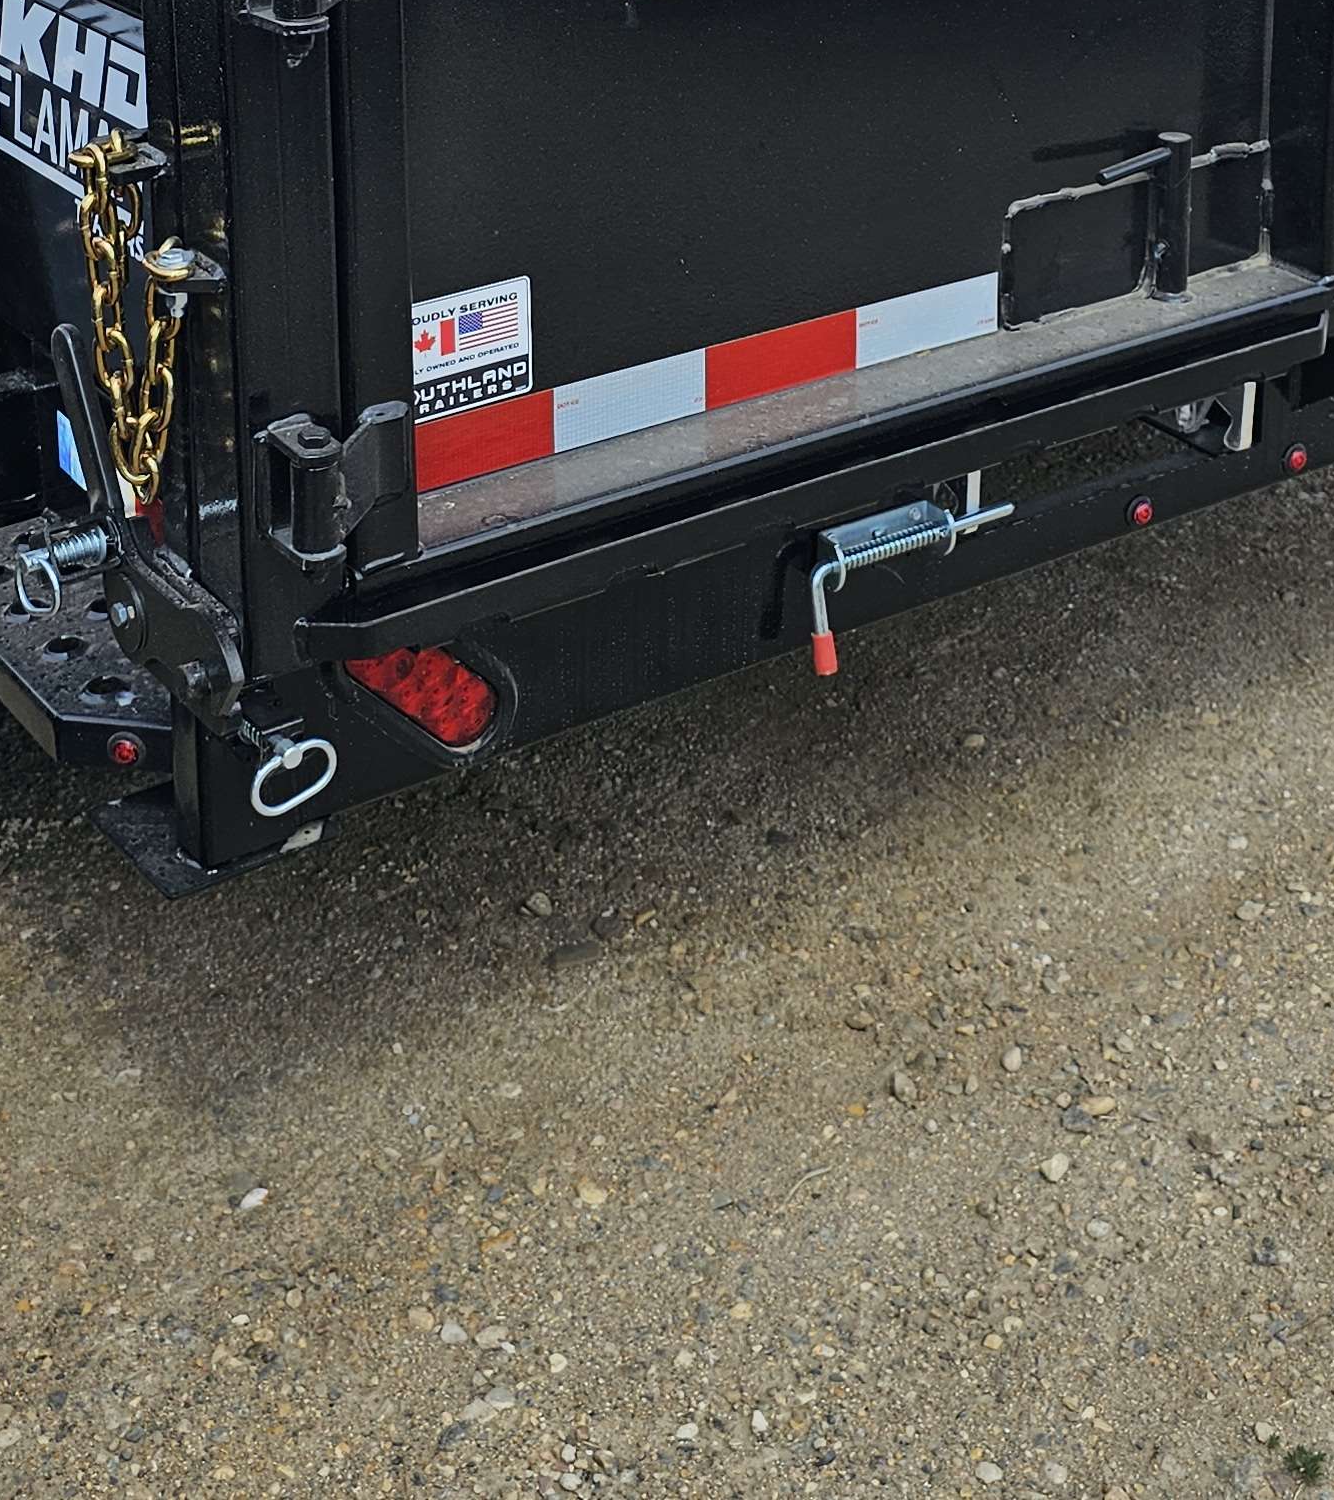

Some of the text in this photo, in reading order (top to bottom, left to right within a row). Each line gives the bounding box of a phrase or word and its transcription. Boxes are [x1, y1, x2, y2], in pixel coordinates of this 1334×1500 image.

[411, 292, 518, 326] OUDLY SERVING
[426, 360, 456, 372] OWNED
[458, 354, 476, 363] AND
[477, 343, 519, 358] OPERATED
[414, 361, 527, 405] UTHLAND
[419, 380, 513, 414] RAILERS
